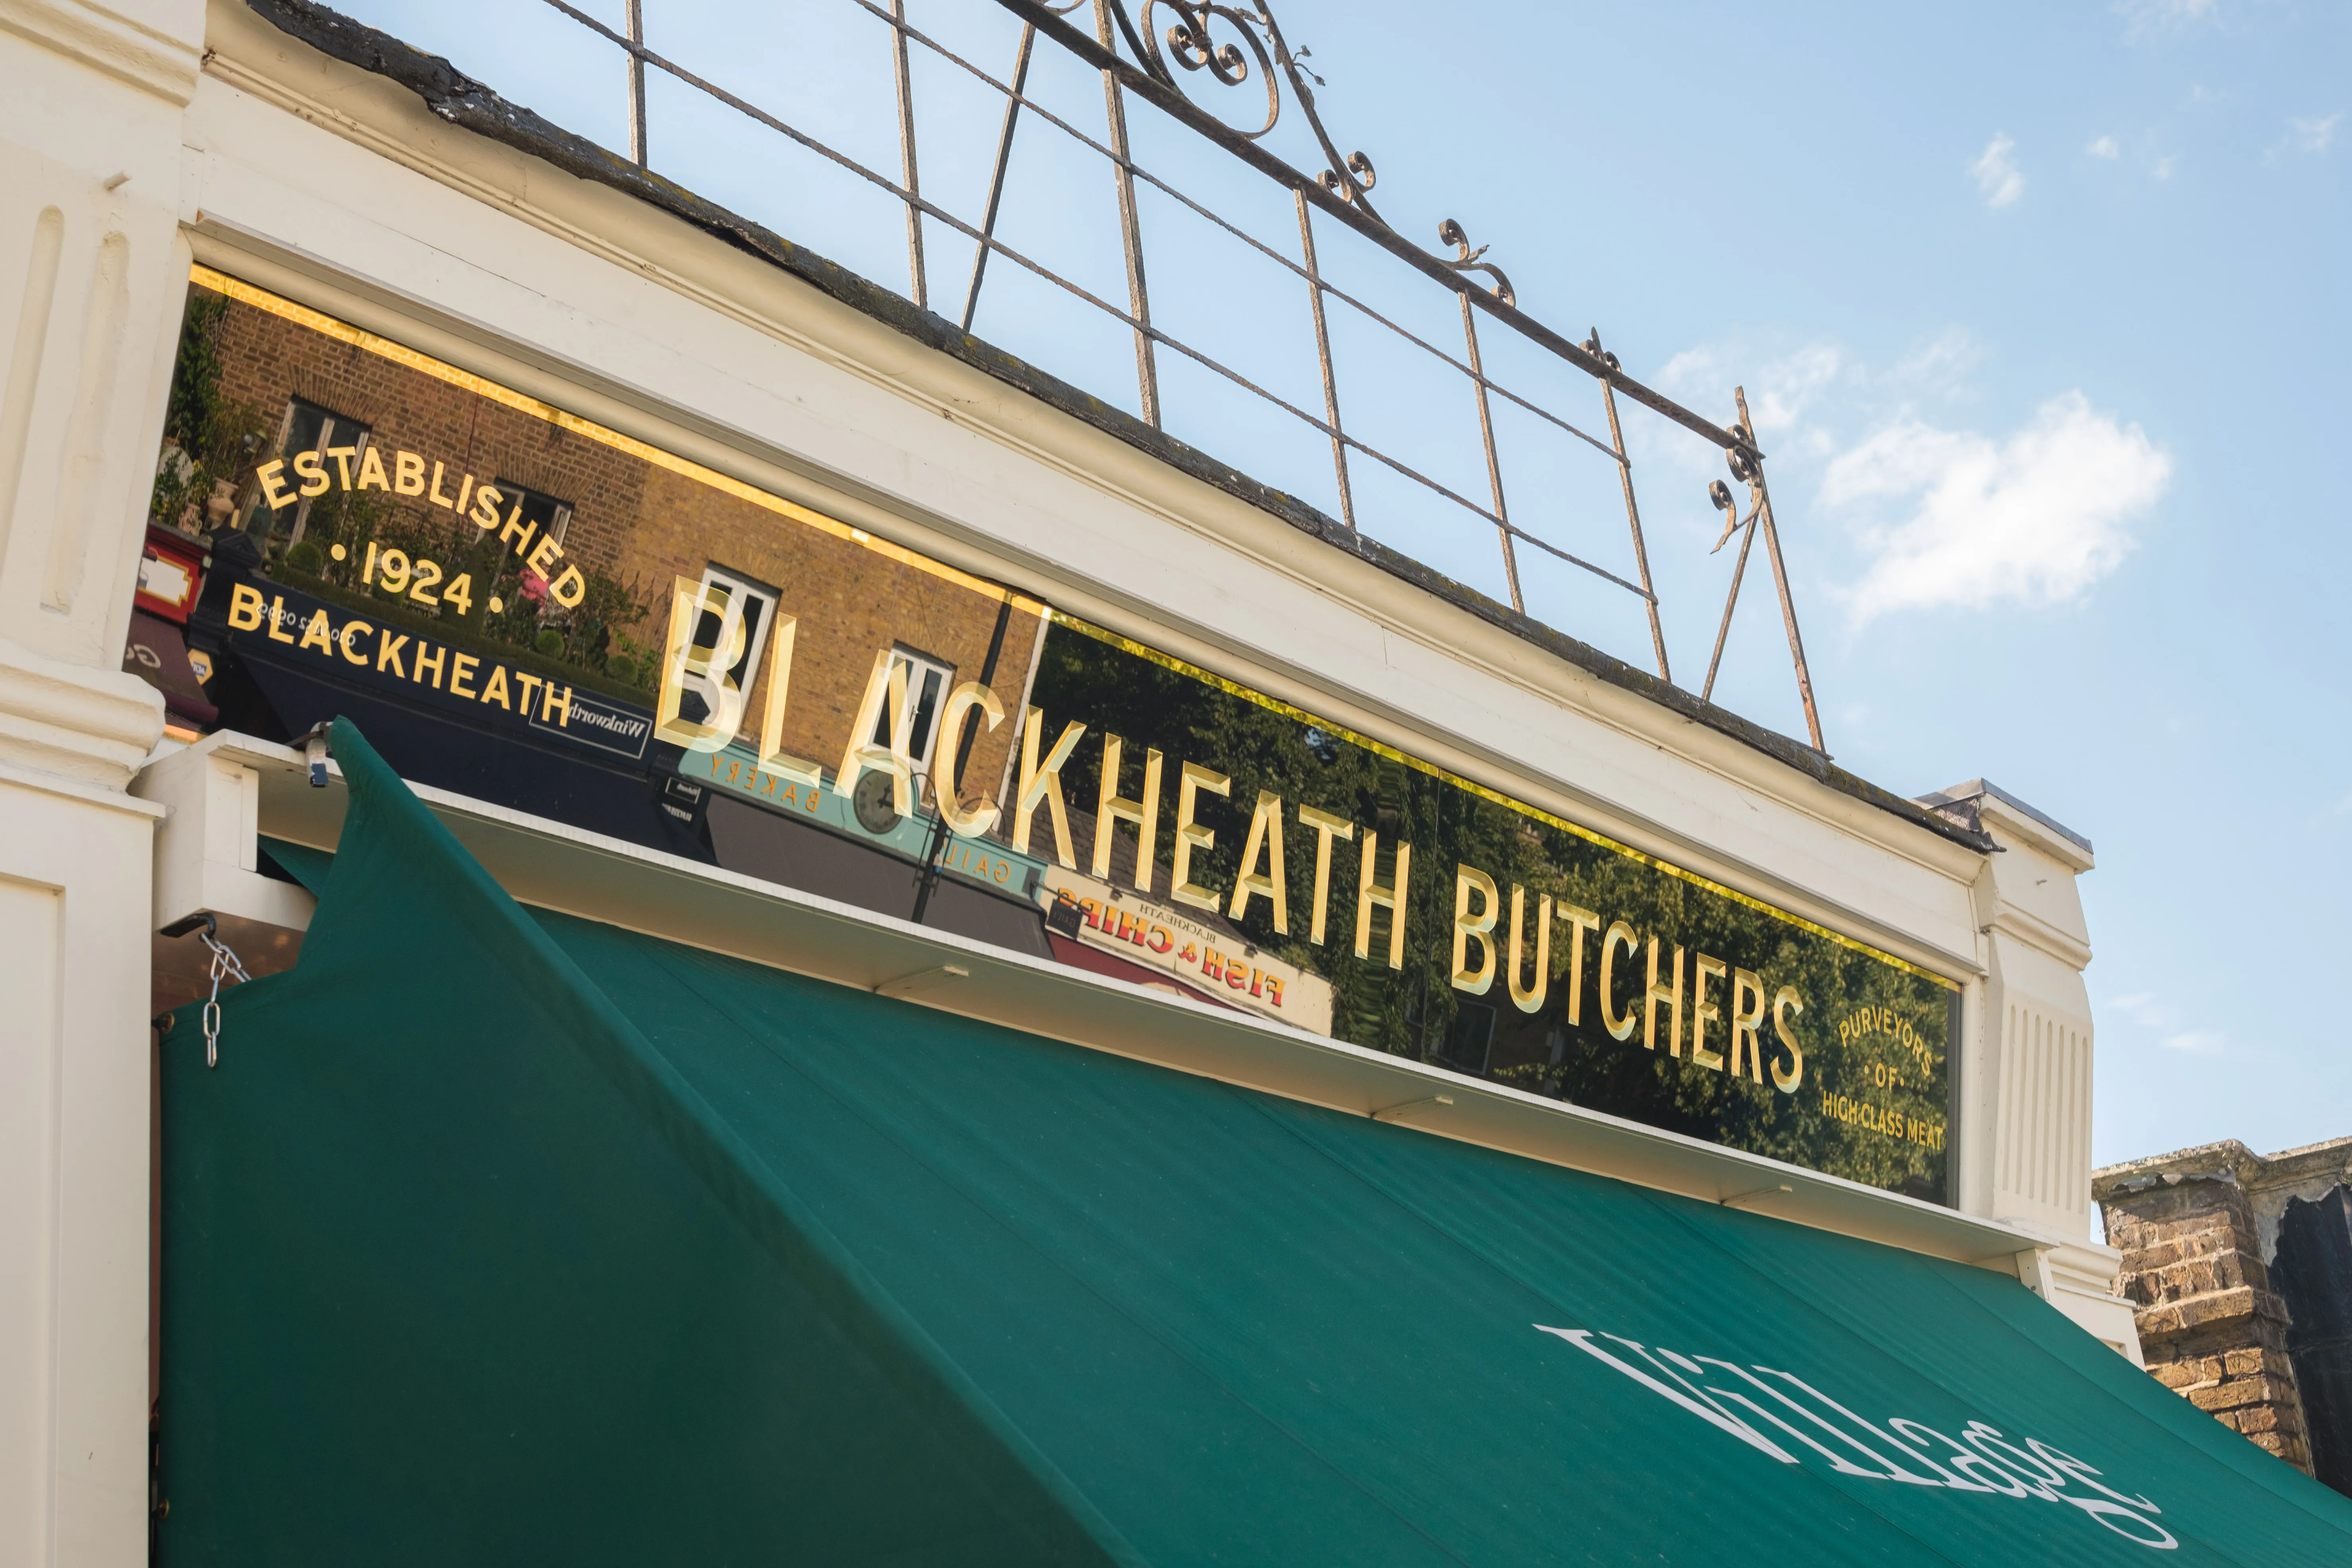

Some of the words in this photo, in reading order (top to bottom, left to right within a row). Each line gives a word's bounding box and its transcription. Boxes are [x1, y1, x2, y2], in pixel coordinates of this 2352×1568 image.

[256, 446, 585, 608] ESTABLISHED
[363, 542, 472, 615] 1924
[227, 583, 572, 727] BLACKHEATH
[654, 575, 1410, 970] BLACKHEATH
[1451, 863, 1804, 1094] BUTCHERS
[1839, 1006, 1931, 1077] PURVEYORS
[1875, 1062, 1897, 1090] OF
[1823, 1090, 1858, 1125] HIGH
[1861, 1103, 1903, 1139] CLASS
[1907, 1117, 1943, 1150] MEAT
[1532, 1324, 2178, 1549] Village
